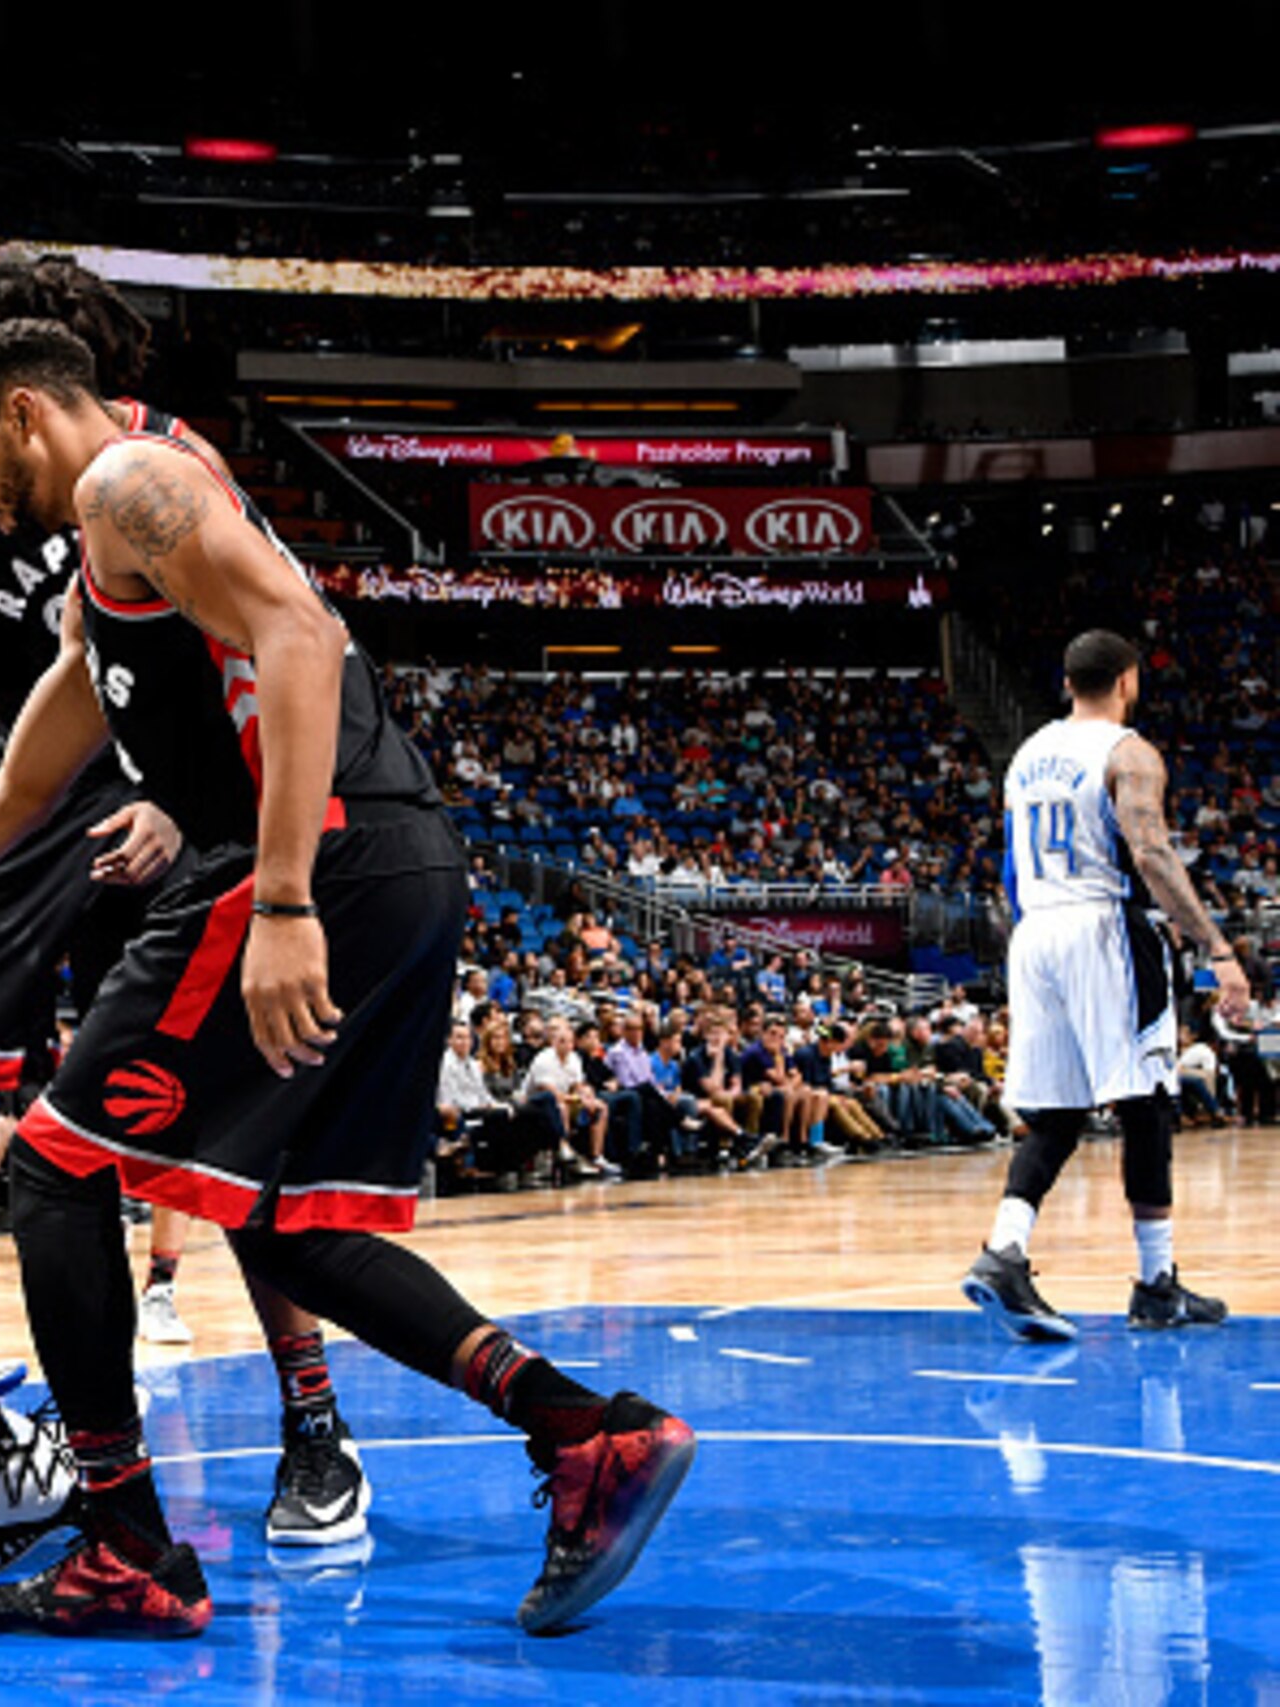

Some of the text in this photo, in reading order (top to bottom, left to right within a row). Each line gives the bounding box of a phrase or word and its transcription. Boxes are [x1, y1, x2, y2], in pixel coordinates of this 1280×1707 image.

[637, 441, 812, 467] Passholder Program
[502, 510, 576, 544] KIA
[632, 512, 707, 545] KIA
[766, 512, 841, 545] KIA
[1027, 799, 1082, 879] 14
